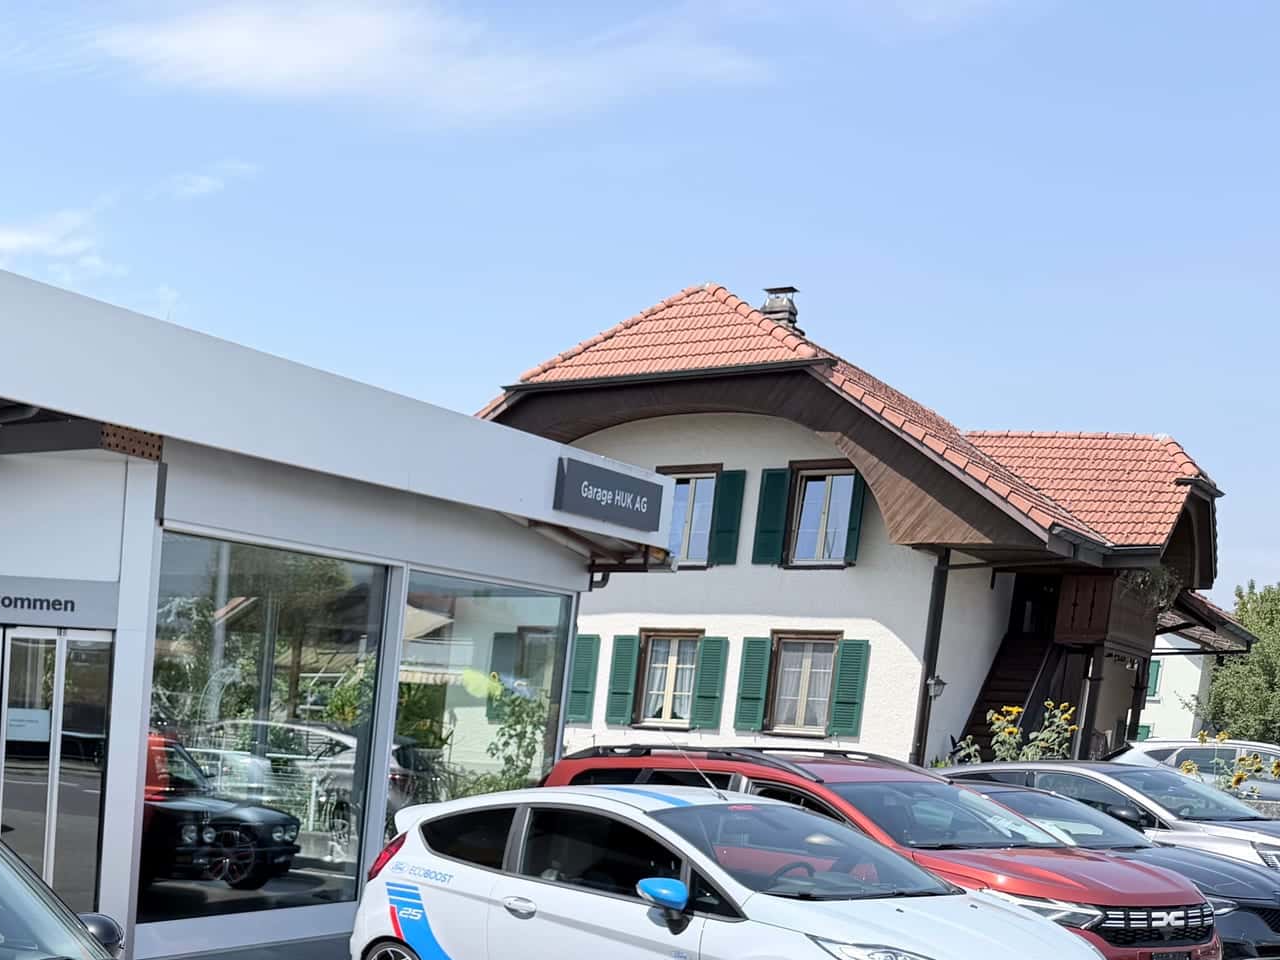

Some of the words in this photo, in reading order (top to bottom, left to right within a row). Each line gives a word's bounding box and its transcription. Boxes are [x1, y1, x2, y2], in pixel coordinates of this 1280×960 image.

[581, 481, 613, 505] Garage
[614, 490, 634, 510] HUK
[634, 496, 648, 513] AG
[408, 865, 454, 885] ECOBOOST
[399, 907, 424, 920] 25
